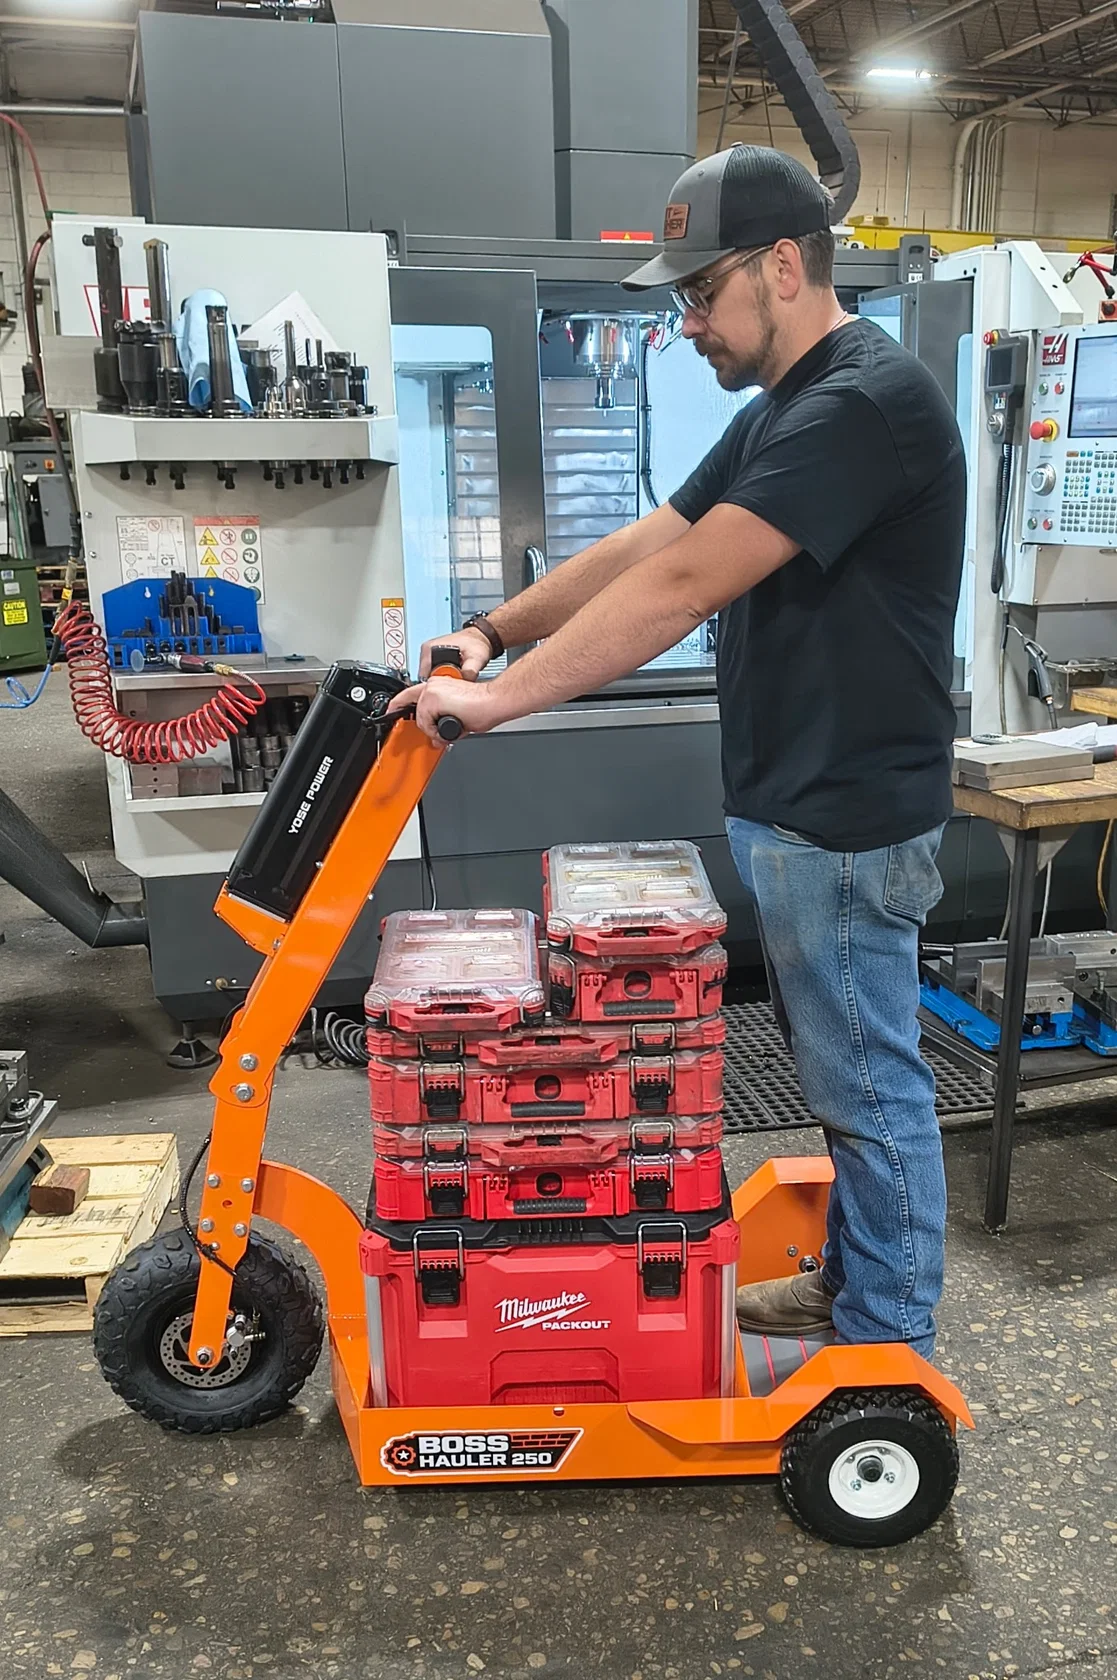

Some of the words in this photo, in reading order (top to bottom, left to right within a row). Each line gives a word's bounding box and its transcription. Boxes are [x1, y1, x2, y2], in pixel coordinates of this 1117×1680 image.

[161, 557, 175, 566] CT
[288, 801, 312, 834] YOSE
[306, 755, 334, 801] POWER
[494, 1291, 587, 1323] Milwaukee
[542, 1320, 611, 1331] PACKOUT
[418, 1435, 509, 1454] BOSS
[419, 1454, 507, 1468] HAULER
[511, 1452, 552, 1466] 250
